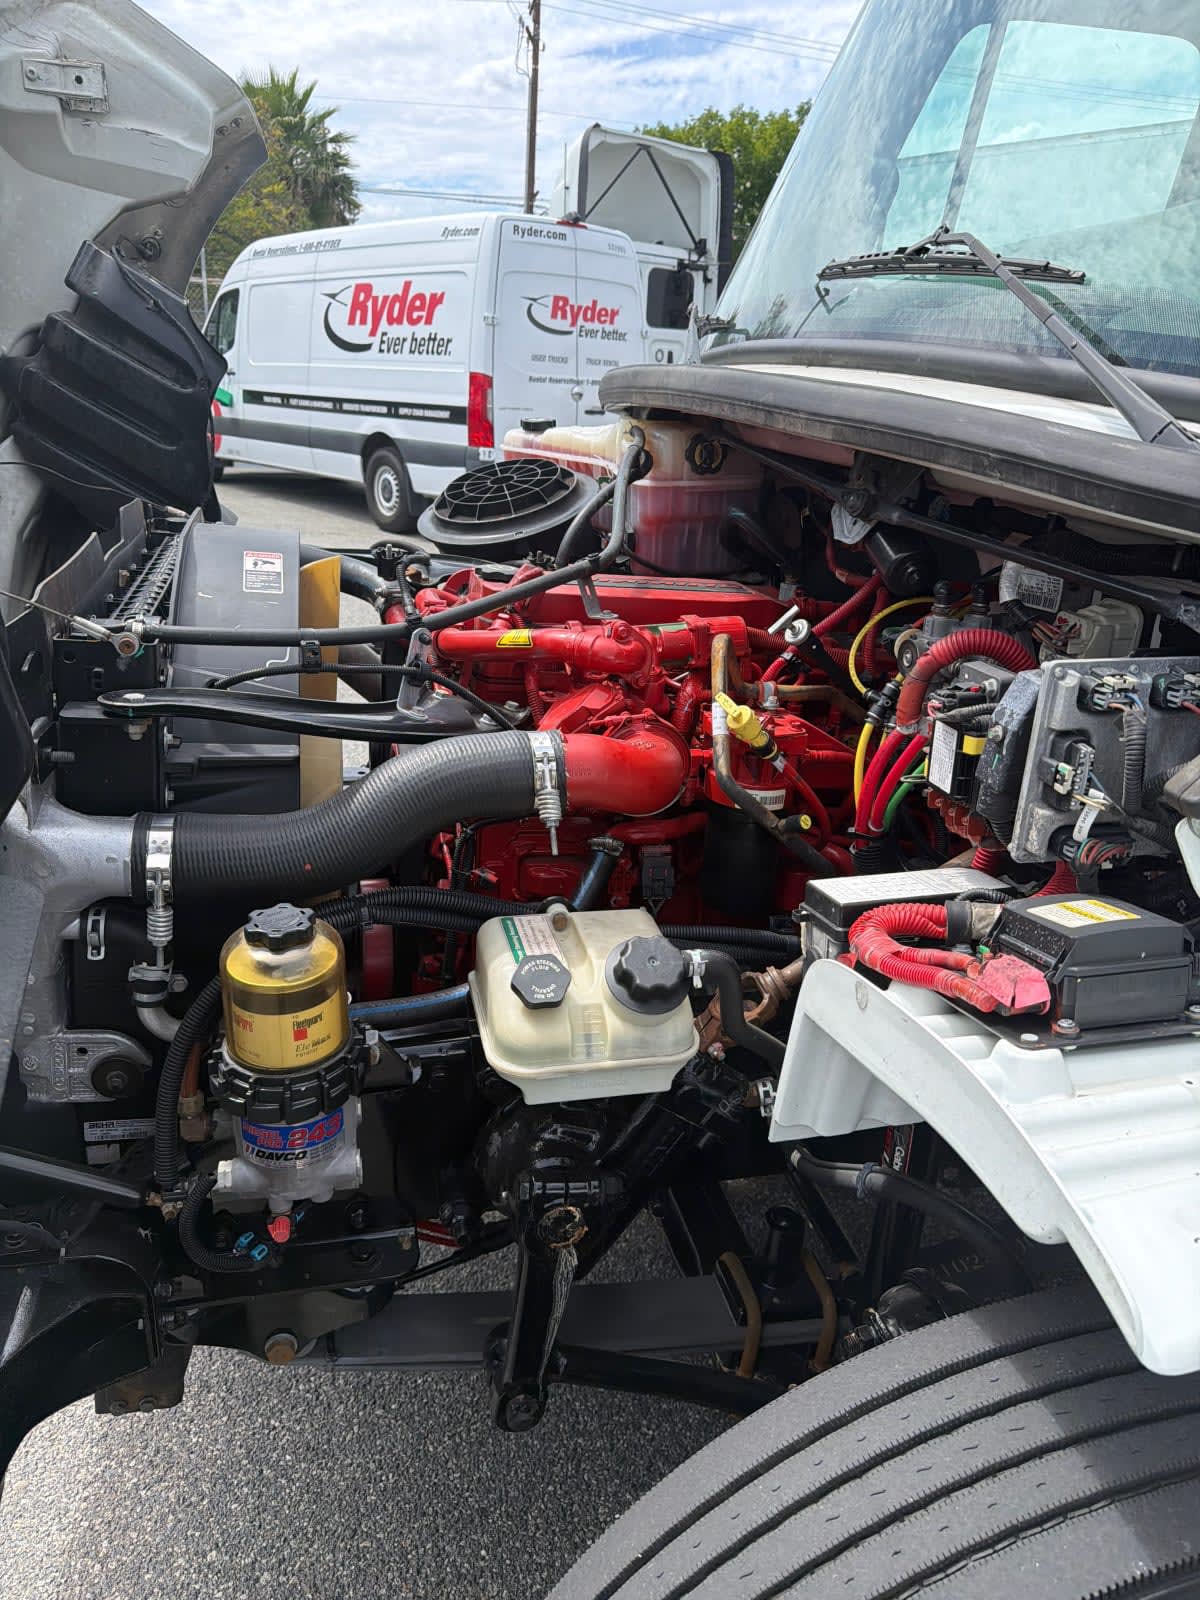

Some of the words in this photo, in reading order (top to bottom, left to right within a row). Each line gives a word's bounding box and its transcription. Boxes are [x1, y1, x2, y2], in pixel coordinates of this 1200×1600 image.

[441, 226, 480, 238] Ryder.com
[513, 224, 567, 240] Ryder.com
[347, 281, 445, 337] Ryder
[551, 295, 620, 327] Ryder
[578, 325, 599, 339] Ever
[378, 332, 407, 354] Ever
[408, 332, 453, 356] better.
[255, 1150, 308, 1161] DAVCO
